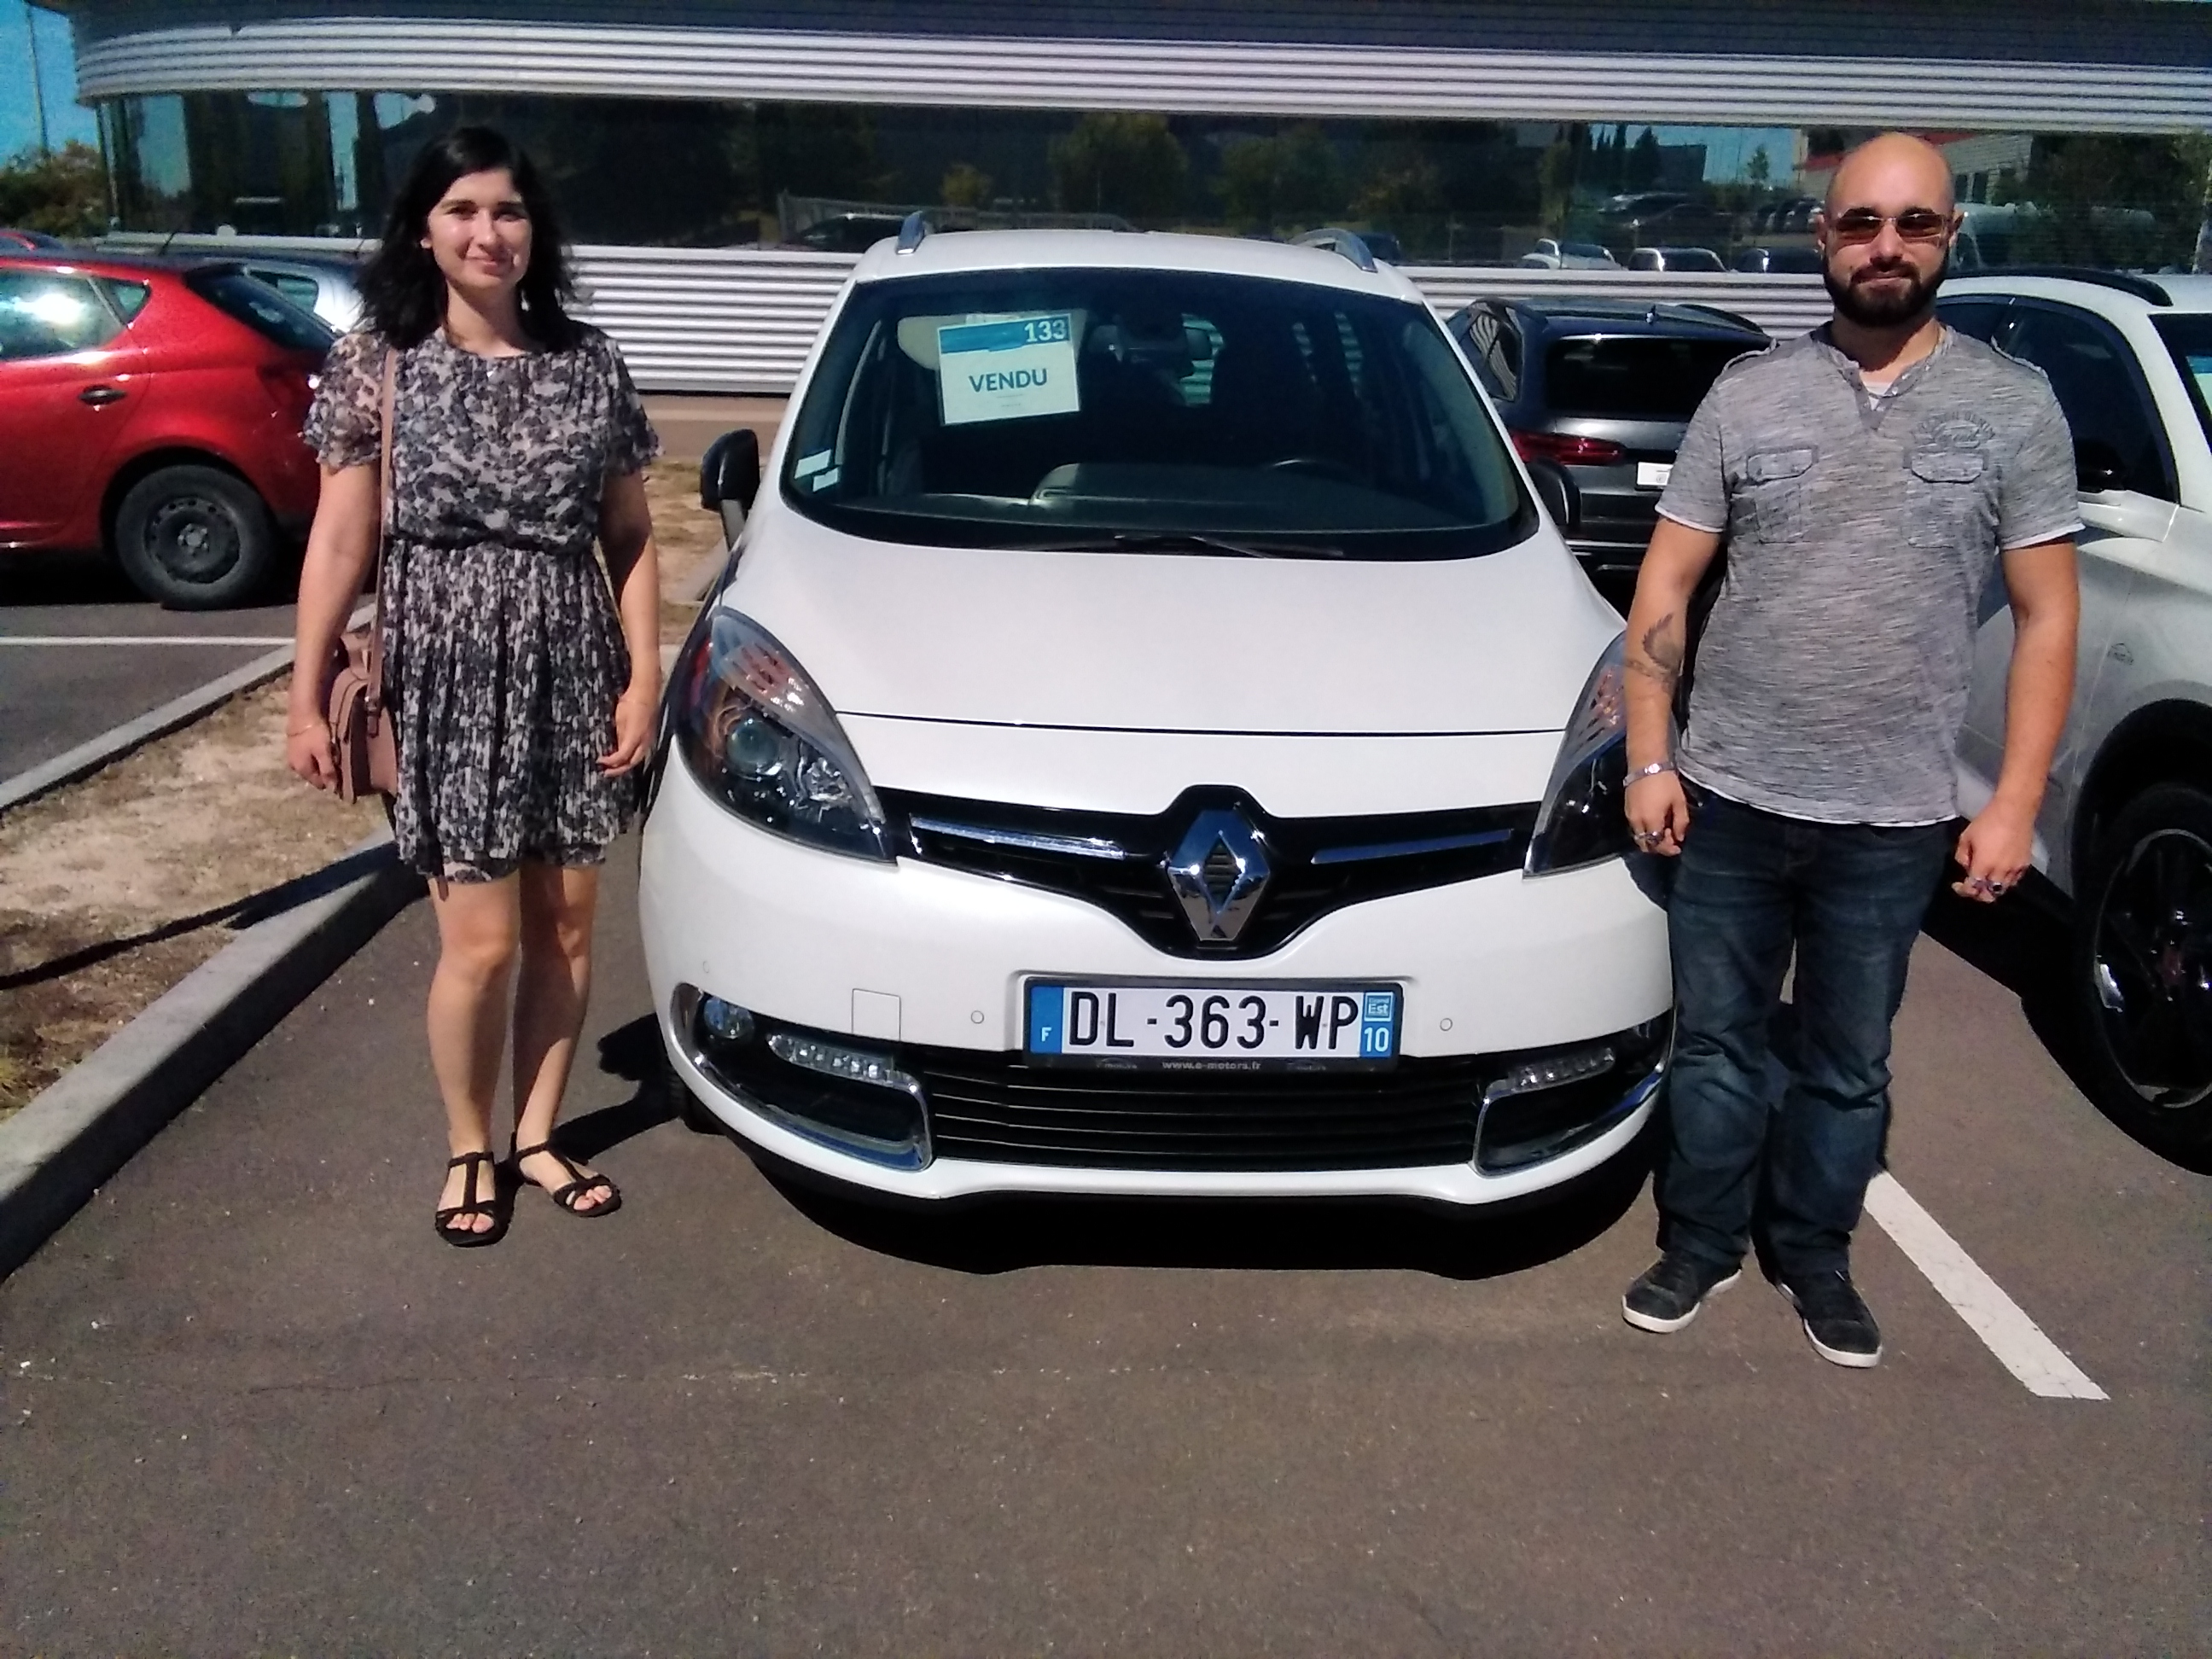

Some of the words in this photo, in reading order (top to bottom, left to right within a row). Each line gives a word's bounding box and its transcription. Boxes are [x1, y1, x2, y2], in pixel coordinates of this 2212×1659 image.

[1024, 319, 1066, 342] 133
[969, 369, 1047, 392] VENDU
[1041, 1027, 1052, 1042] F
[1364, 1027, 1389, 1052] 10
